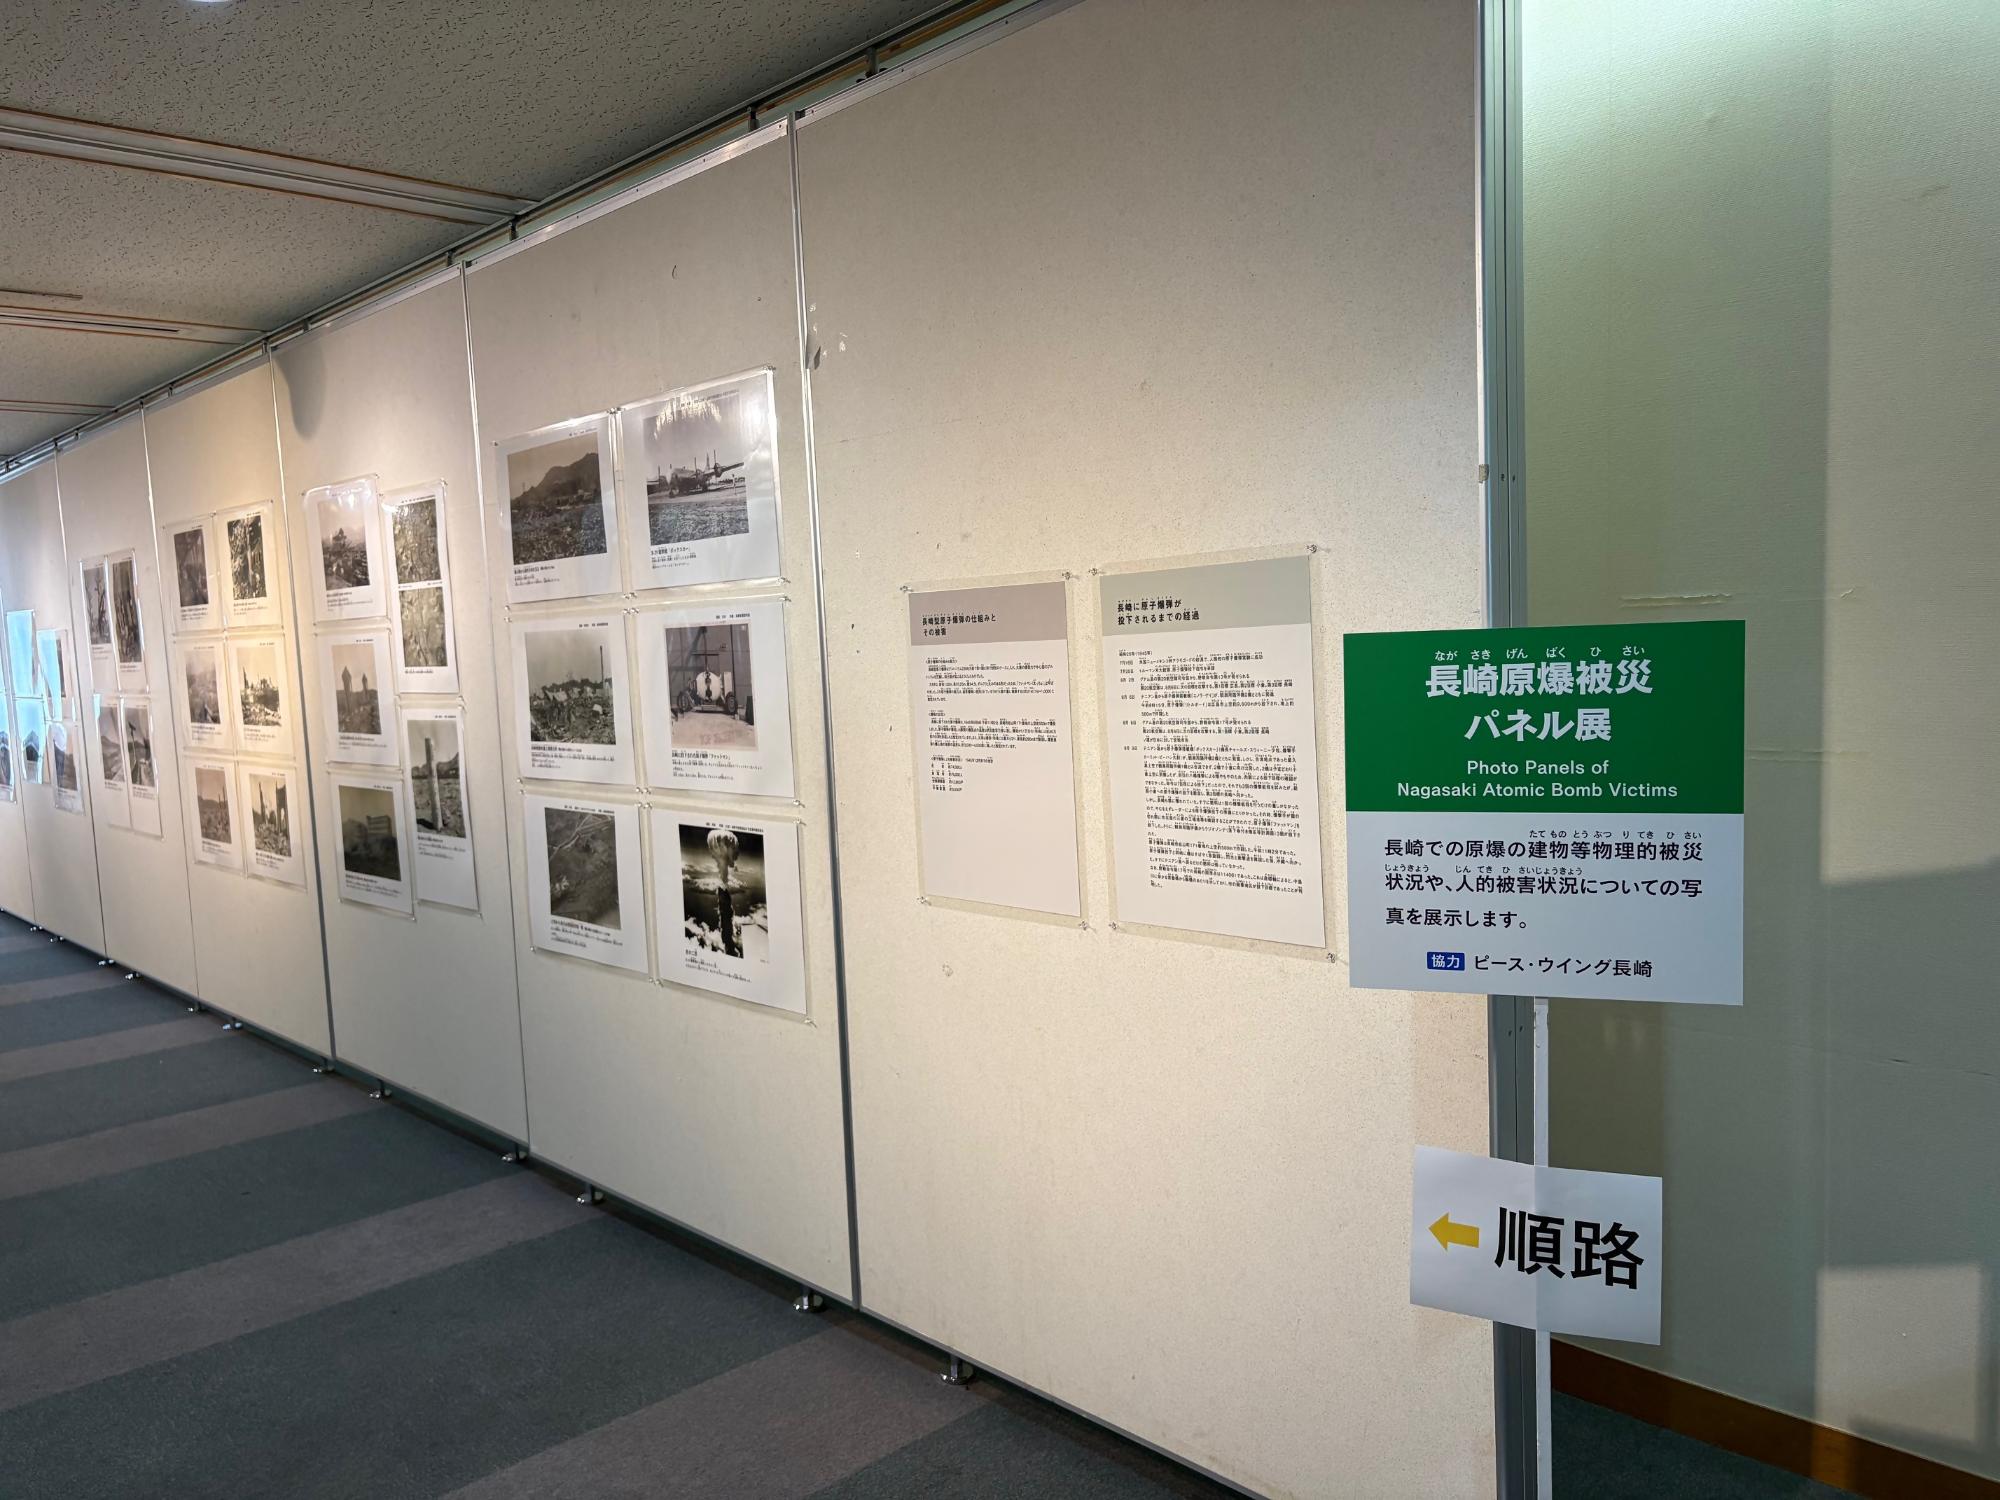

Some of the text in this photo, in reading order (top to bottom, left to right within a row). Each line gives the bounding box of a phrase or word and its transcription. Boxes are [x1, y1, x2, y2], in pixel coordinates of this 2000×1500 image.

[1117, 599, 1182, 613] 長崎に原子爆弾が
[1118, 610, 1200, 626] 投下されるまでの経過
[1435, 645, 1645, 661] なが さき げん ばく ひ さい
[1425, 659, 1653, 698] 長崎原爆被災
[1464, 708, 1612, 742] パネル展
[1466, 759, 1609, 775] Photo Panels of
[1397, 781, 1678, 801] Nagasaki Atomic Bomb Victims
[1384, 839, 1703, 861] 長崎での原爆の建物等物理的被災
[1385, 875, 1703, 897] 状況や、人的被害状況についての写
[1385, 907, 1529, 930] 真を展示します。
[1430, 953, 1653, 978] 協力 ピース・ウイング長崎
[1494, 1206, 1645, 1290] 順路
